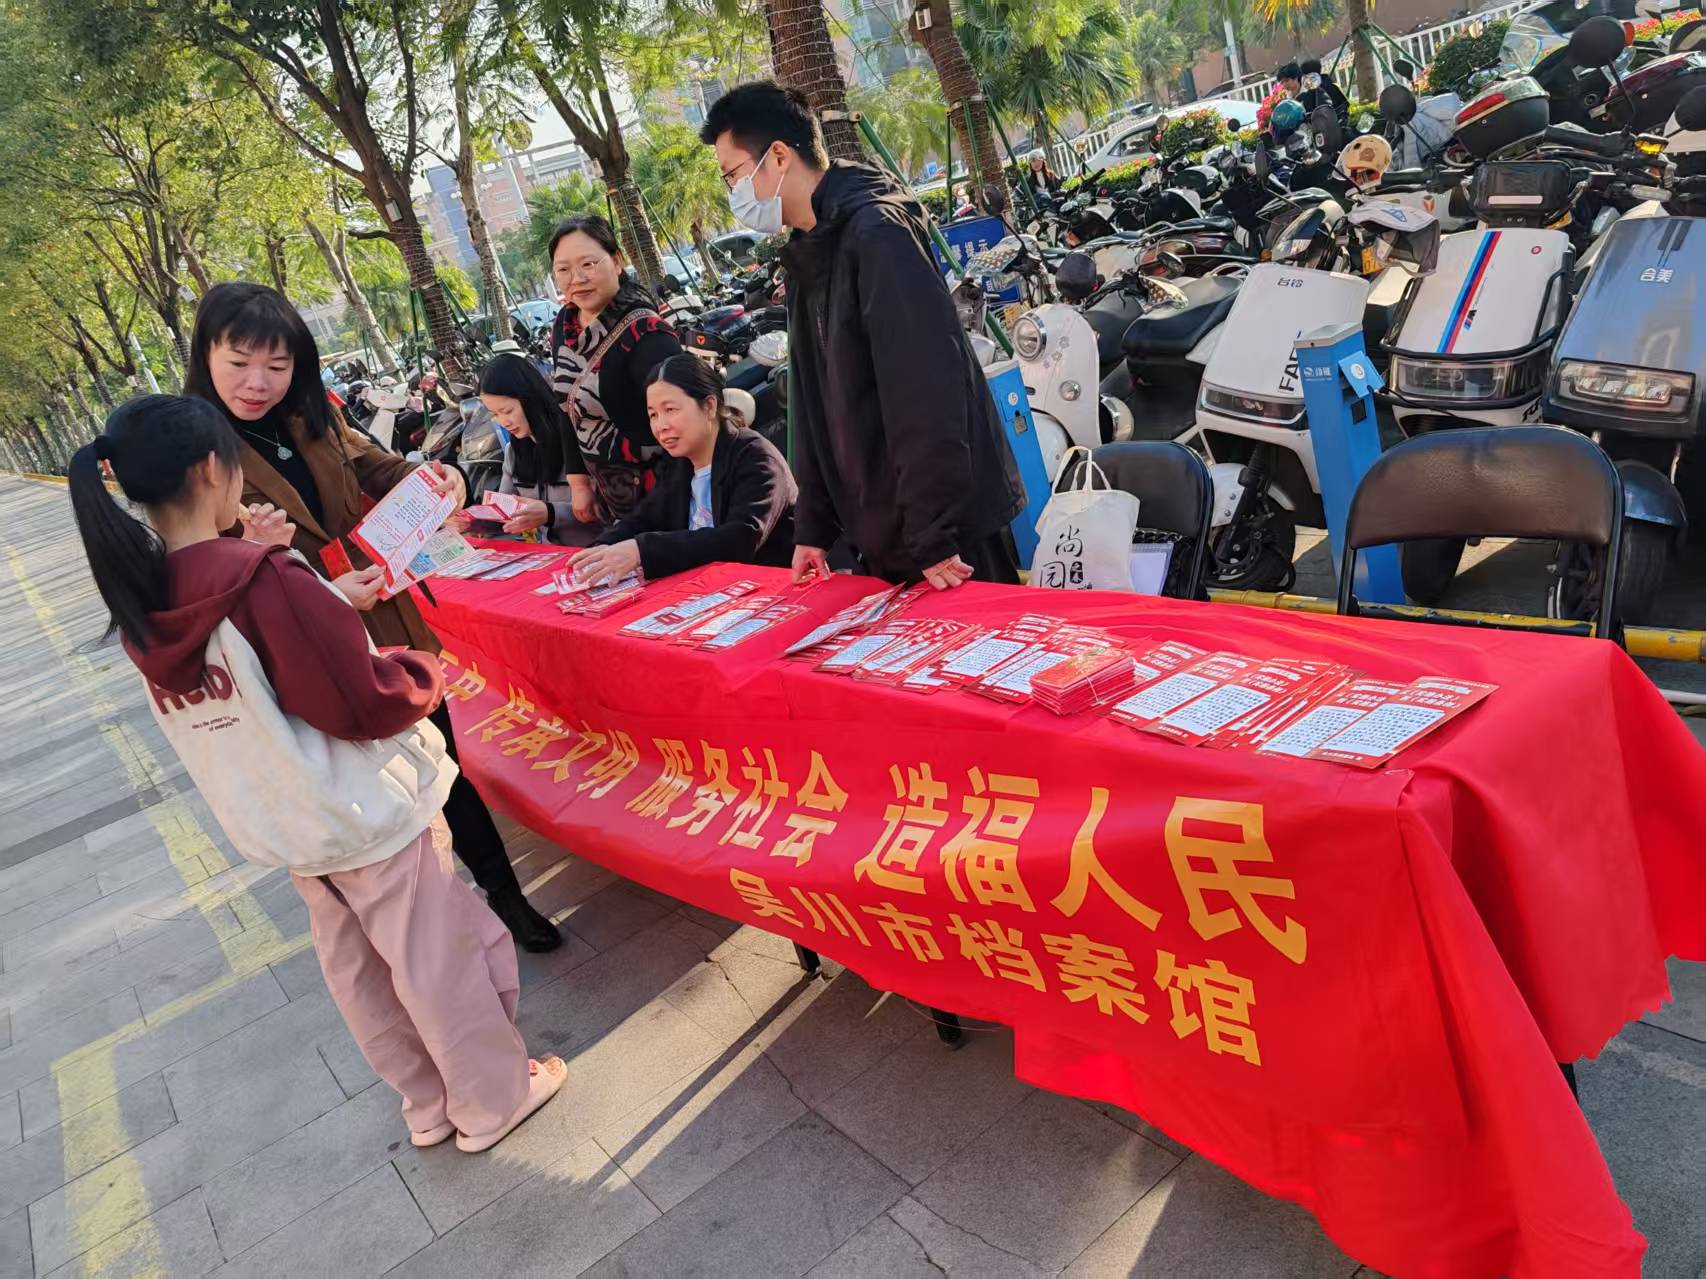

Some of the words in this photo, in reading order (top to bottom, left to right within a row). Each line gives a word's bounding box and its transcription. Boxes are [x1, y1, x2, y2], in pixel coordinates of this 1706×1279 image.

[464, 682, 640, 800] 传承文明
[625, 737, 849, 868] 服务社会
[853, 761, 1308, 965] 造福人民
[729, 867, 1262, 1067] 吴川市档案馆
